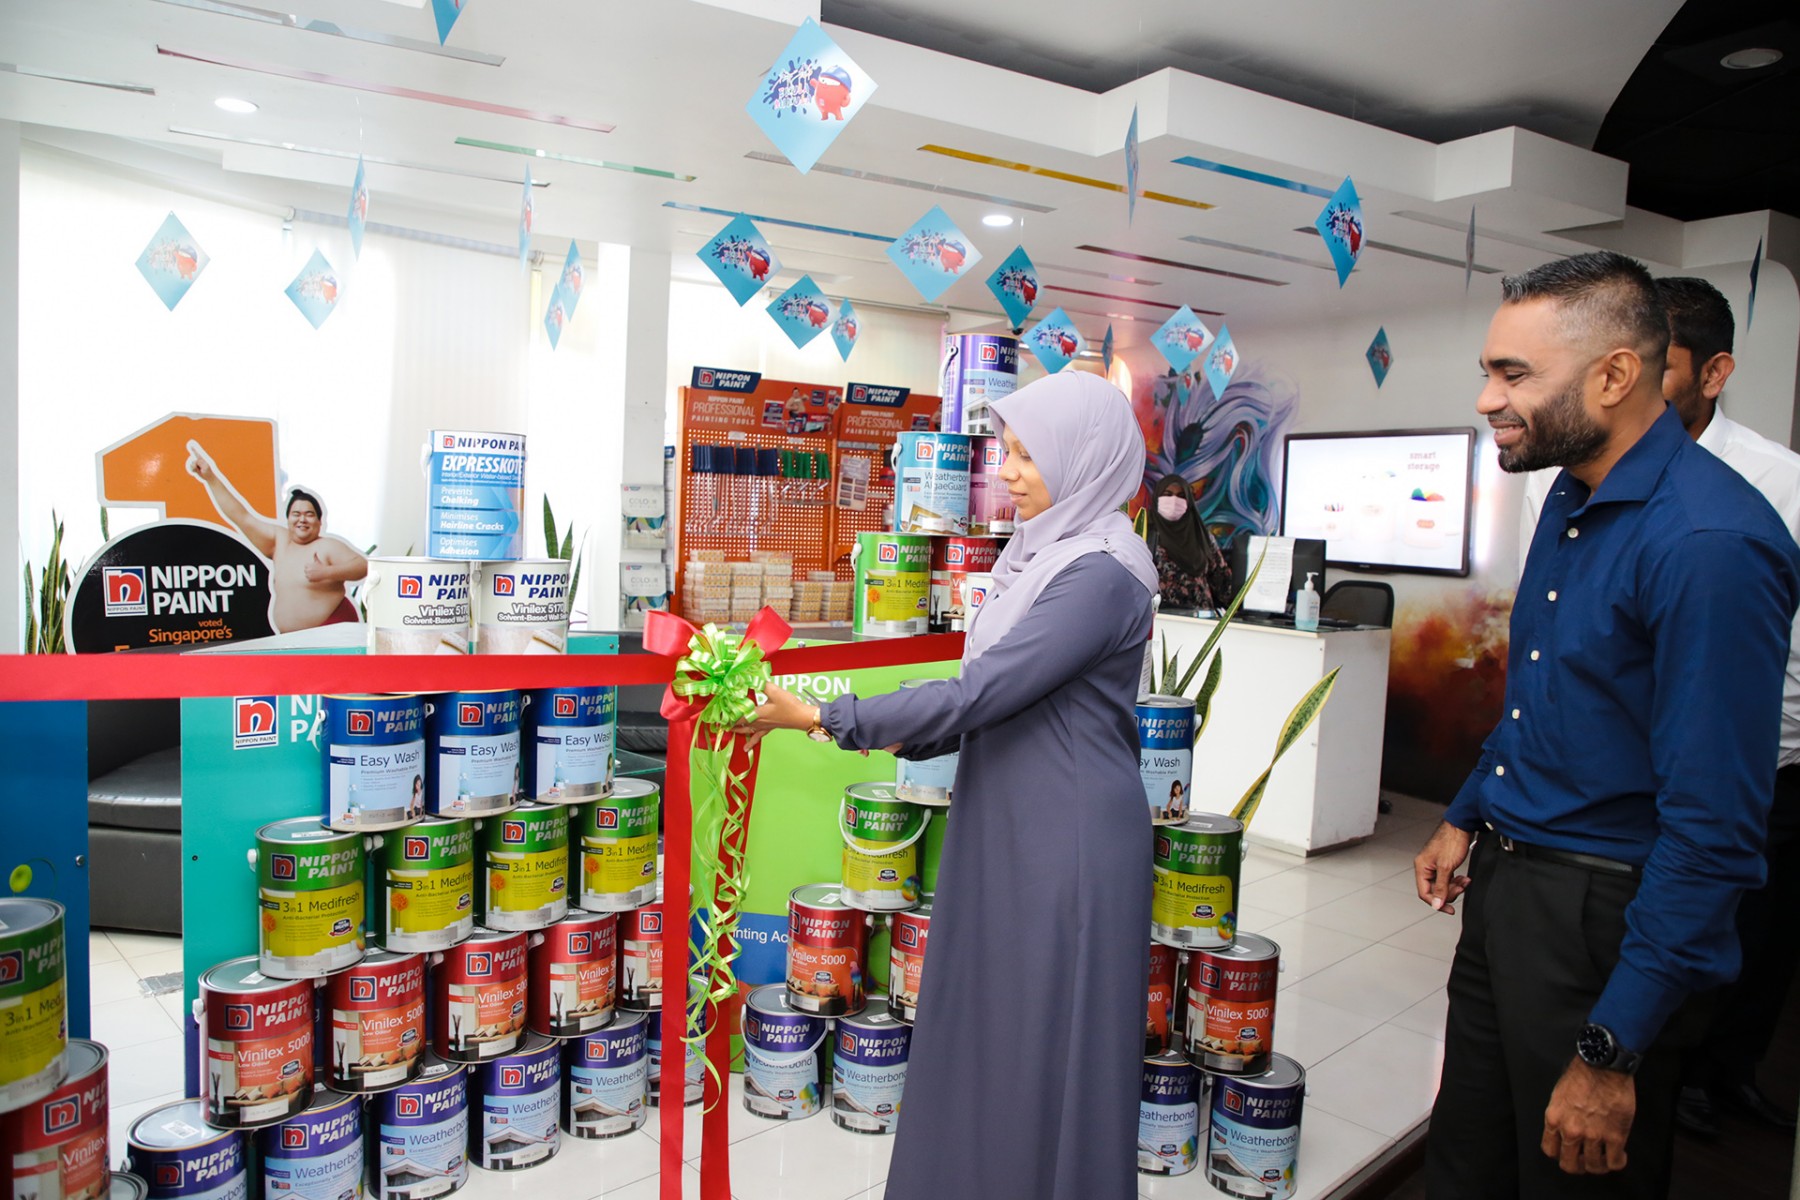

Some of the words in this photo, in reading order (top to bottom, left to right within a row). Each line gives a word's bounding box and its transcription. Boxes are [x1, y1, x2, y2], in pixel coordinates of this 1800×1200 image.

[716, 371, 752, 382] NIPPON
[719, 380, 747, 389] PAINT
[868, 387, 901, 397] NIPPON
[692, 402, 755, 417] PROFESSIONAL
[692, 415, 729, 424] PAINTING
[732, 417, 755, 426] TOOLS
[847, 416, 904, 430] PROFESSIONAL
[845, 428, 881, 437] PAINTING
[457, 437, 508, 449] NIPPON
[1409, 451, 1437, 460] smart
[1407, 462, 1441, 473] storage
[441, 486, 473, 496] Prevents
[441, 495, 480, 507] Chalking
[440, 511, 479, 521] Minimises
[440, 521, 474, 530] Hairline
[475, 521, 505, 531] Cracks
[440, 537, 478, 547] Optimises
[439, 546, 480, 556] Adhesion
[151, 565, 257, 590] NIPPON
[153, 590, 234, 616] PAINT
[419, 603, 456, 617] Vinilex
[511, 601, 548, 616] Vinilex
[198, 618, 224, 629] voted
[403, 616, 456, 626] Solvent-Based
[497, 615, 548, 625] Solvent-Based
[148, 625, 233, 646] Singapore's
[1140, 716, 1190, 730] NIPPON
[1146, 728, 1187, 740] PAINT
[565, 735, 591, 750] Easy
[470, 744, 498, 758] Easy
[360, 754, 391, 768] Easy
[394, 749, 420, 764] Wash
[1153, 755, 1181, 769] Wash
[858, 809, 909, 823] NIPPON
[864, 820, 903, 832] PAINT
[1173, 841, 1227, 855] NIPPON
[299, 847, 359, 868] NIPPON
[1178, 852, 1223, 866] PAINT
[307, 861, 356, 878] PAINT
[1177, 879, 1225, 895] Medifresh
[308, 891, 360, 912] Medifresh
[801, 916, 851, 930] NIPPON
[805, 927, 845, 940] PAINT
[791, 950, 818, 966] Vinilex
[820, 954, 847, 966] 5000
[579, 967, 610, 981] Vinilex
[478, 989, 514, 1005] Vinilex
[265, 1002, 309, 1027] PAINT
[1206, 1003, 1243, 1021] Vinilex
[1246, 1007, 1269, 1020] 5000
[362, 1016, 404, 1032] Vinilex
[761, 1022, 811, 1034] NIPPON
[766, 1033, 807, 1045] PAINT
[858, 1036, 908, 1049] NIPPON
[238, 1046, 285, 1063] Vinilex
[287, 1032, 312, 1054] 5000
[864, 1047, 904, 1058] PAINT
[1149, 1084, 1189, 1096] PAINT
[1230, 1129, 1297, 1149] Weatherbond
[62, 1134, 106, 1167] Vinilex
